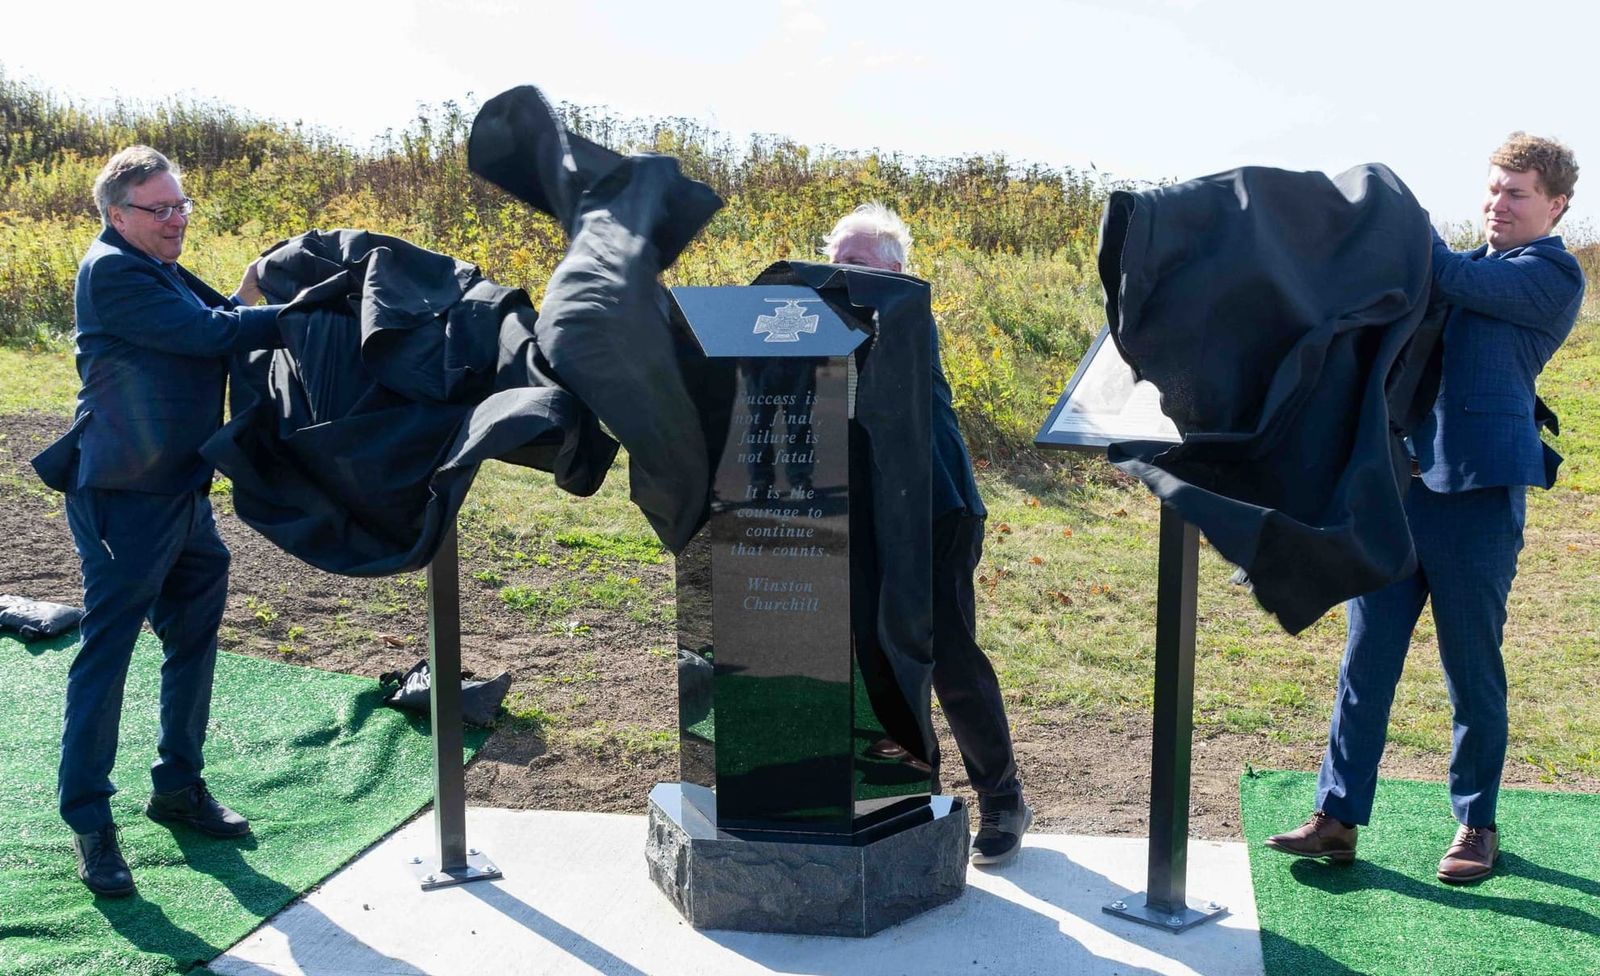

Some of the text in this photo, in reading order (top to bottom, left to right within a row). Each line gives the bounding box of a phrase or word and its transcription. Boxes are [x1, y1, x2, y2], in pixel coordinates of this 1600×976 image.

[805, 390, 820, 406] is
[735, 410, 822, 427] not final,
[737, 430, 820, 445] failure is
[737, 449, 821, 466] not fatal.
[744, 483, 815, 500] It is the
[736, 507, 823, 521] courage to
[745, 523, 815, 538] continue
[730, 542, 831, 558] that counts.
[747, 577, 814, 593] Winston
[743, 595, 820, 612] Churchill
